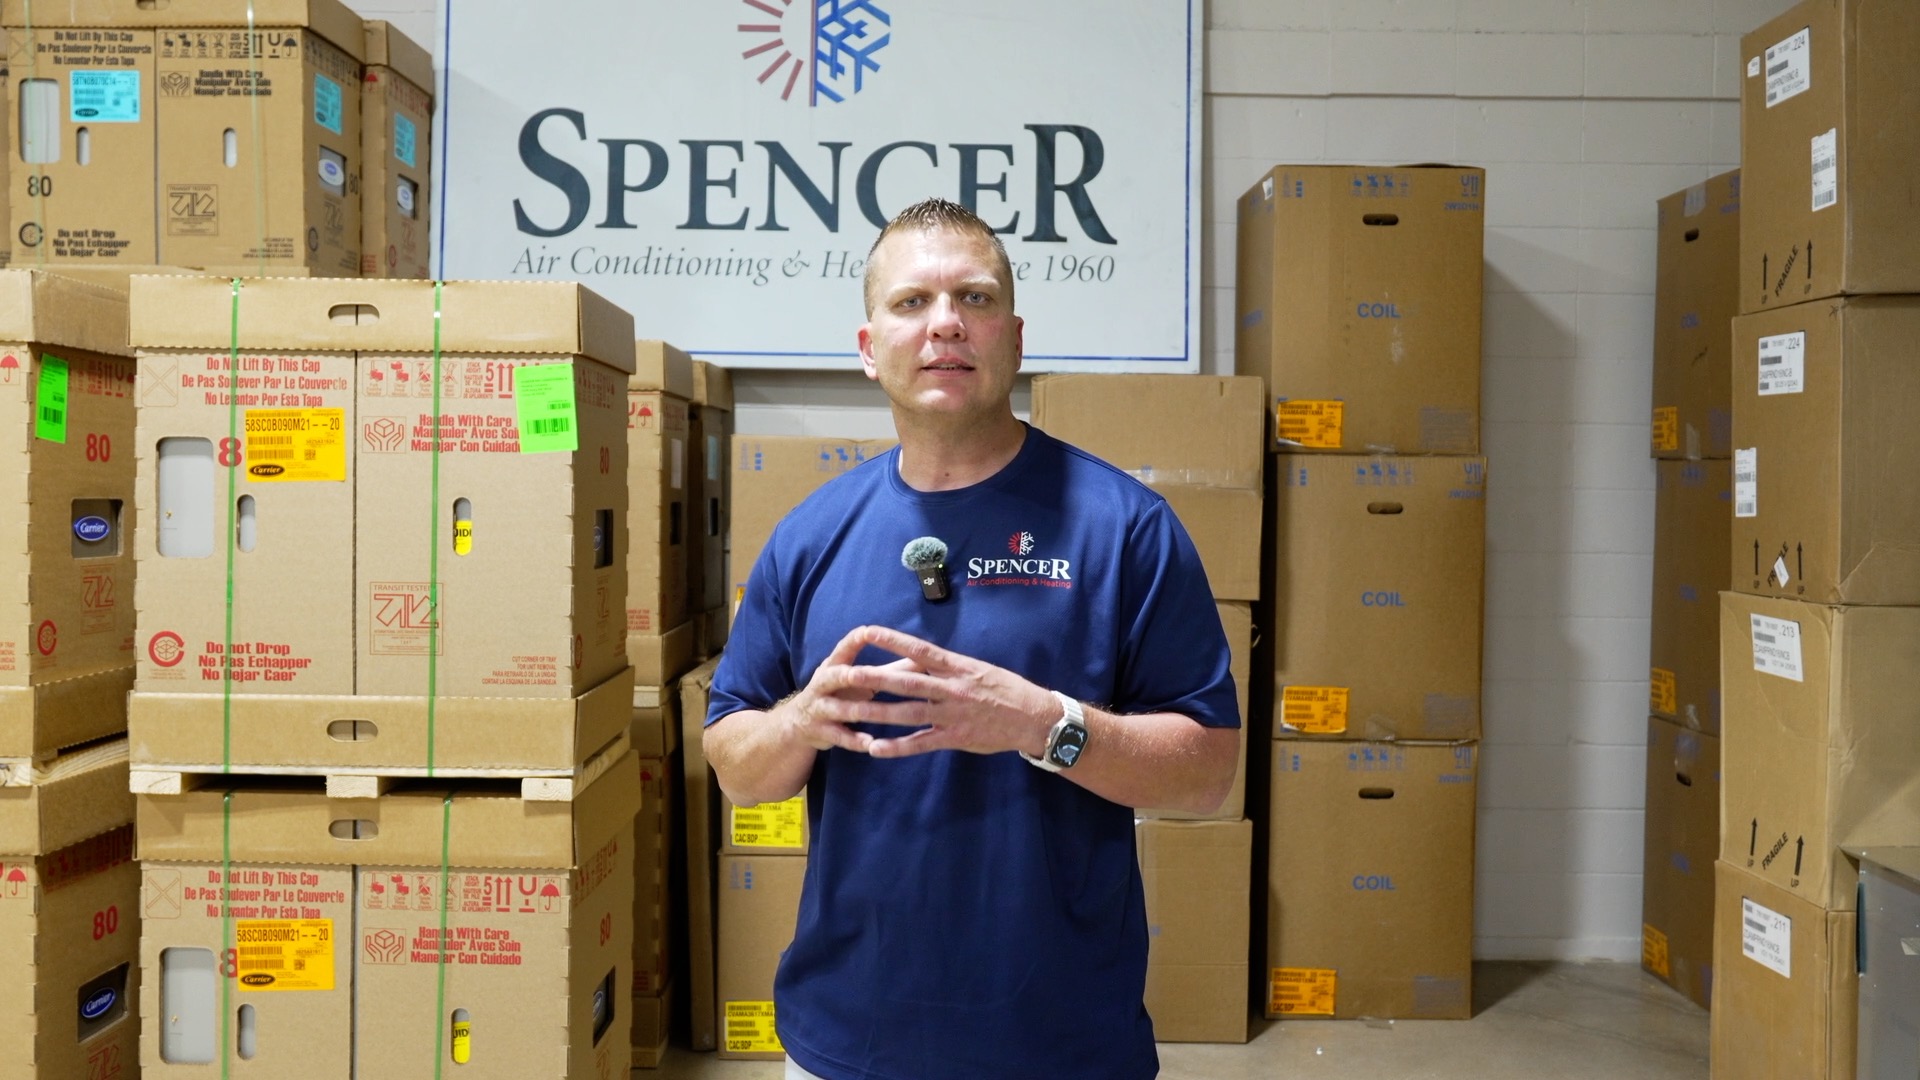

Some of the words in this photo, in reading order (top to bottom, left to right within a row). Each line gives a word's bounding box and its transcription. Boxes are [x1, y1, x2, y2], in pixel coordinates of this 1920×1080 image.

[512, 106, 1118, 246] SPENCER
[28, 176, 52, 197] 80
[58, 229, 70, 238] Do
[72, 229, 88, 238] not
[92, 229, 116, 239] Drop
[56, 248, 68, 256] No
[511, 246, 560, 275] Air
[570, 246, 772, 287] Conditioning
[782, 250, 810, 278] &
[1043, 255, 1115, 282] 1960
[1774, 244, 1799, 297] FRAGILE
[1357, 303, 1400, 318] COIL
[206, 357, 220, 370] Do
[223, 358, 240, 370] Nt
[243, 358, 258, 370] Lift
[262, 358, 274, 373] By
[278, 358, 298, 372] This
[302, 359, 320, 374] Cap
[486, 362, 494, 382] 5
[182, 374, 194, 388] De
[198, 374, 215, 388] Pas
[218, 375, 260, 388] Solever
[264, 376, 282, 388] Par
[284, 376, 296, 388] Le
[298, 376, 347, 390] Couvercle
[205, 392, 217, 405] No
[220, 392, 259, 406] Leantar
[262, 393, 278, 406] Por
[281, 394, 299, 406] Esta
[302, 394, 322, 408] Tapa
[419, 414, 454, 426] Hadle
[458, 414, 483, 427] With
[486, 415, 512, 428] Care
[412, 426, 468, 440] Manpuler
[470, 426, 498, 438] Avec
[86, 433, 111, 463] 80
[411, 440, 456, 453] Manjar
[460, 440, 480, 452] Con
[600, 446, 609, 474] 80
[968, 558, 1072, 580] SPENCER
[980, 578, 1030, 586] Conditioning
[1040, 579, 1072, 589] Heating
[1362, 592, 1406, 606] COIL
[206, 642, 224, 654] Do
[229, 642, 252, 654] not
[256, 642, 290, 656] Drop
[198, 655, 216, 667] Ne
[248, 656, 312, 670] Echapper
[202, 668, 220, 680] No
[264, 670, 296, 681] Caer
[1761, 832, 1788, 870] FRAGILE
[208, 870, 221, 883] Do
[244, 871, 258, 884] Lift
[262, 872, 274, 886] By
[277, 872, 297, 884] This
[300, 872, 318, 887] Cap
[484, 876, 492, 895] 5
[1353, 876, 1396, 890] COIL
[1790, 878, 1799, 888] UP
[184, 887, 196, 900] De
[200, 888, 216, 900] Pas
[264, 888, 280, 902] Par
[284, 889, 294, 902] Le
[298, 889, 344, 902] Couvercle
[207, 904, 218, 918] No
[221, 905, 259, 918] Lvantar
[261, 906, 278, 918] Por
[280, 906, 298, 918] Esta
[301, 906, 320, 920] Tapa
[93, 906, 118, 940] 80
[600, 912, 611, 946] 80
[419, 926, 454, 938] Hanle
[456, 928, 481, 940] With
[484, 928, 510, 940] Care
[469, 939, 496, 951] Avec
[498, 940, 521, 952] Soin
[458, 952, 478, 964] Con
[480, 952, 522, 965] Cuidado
